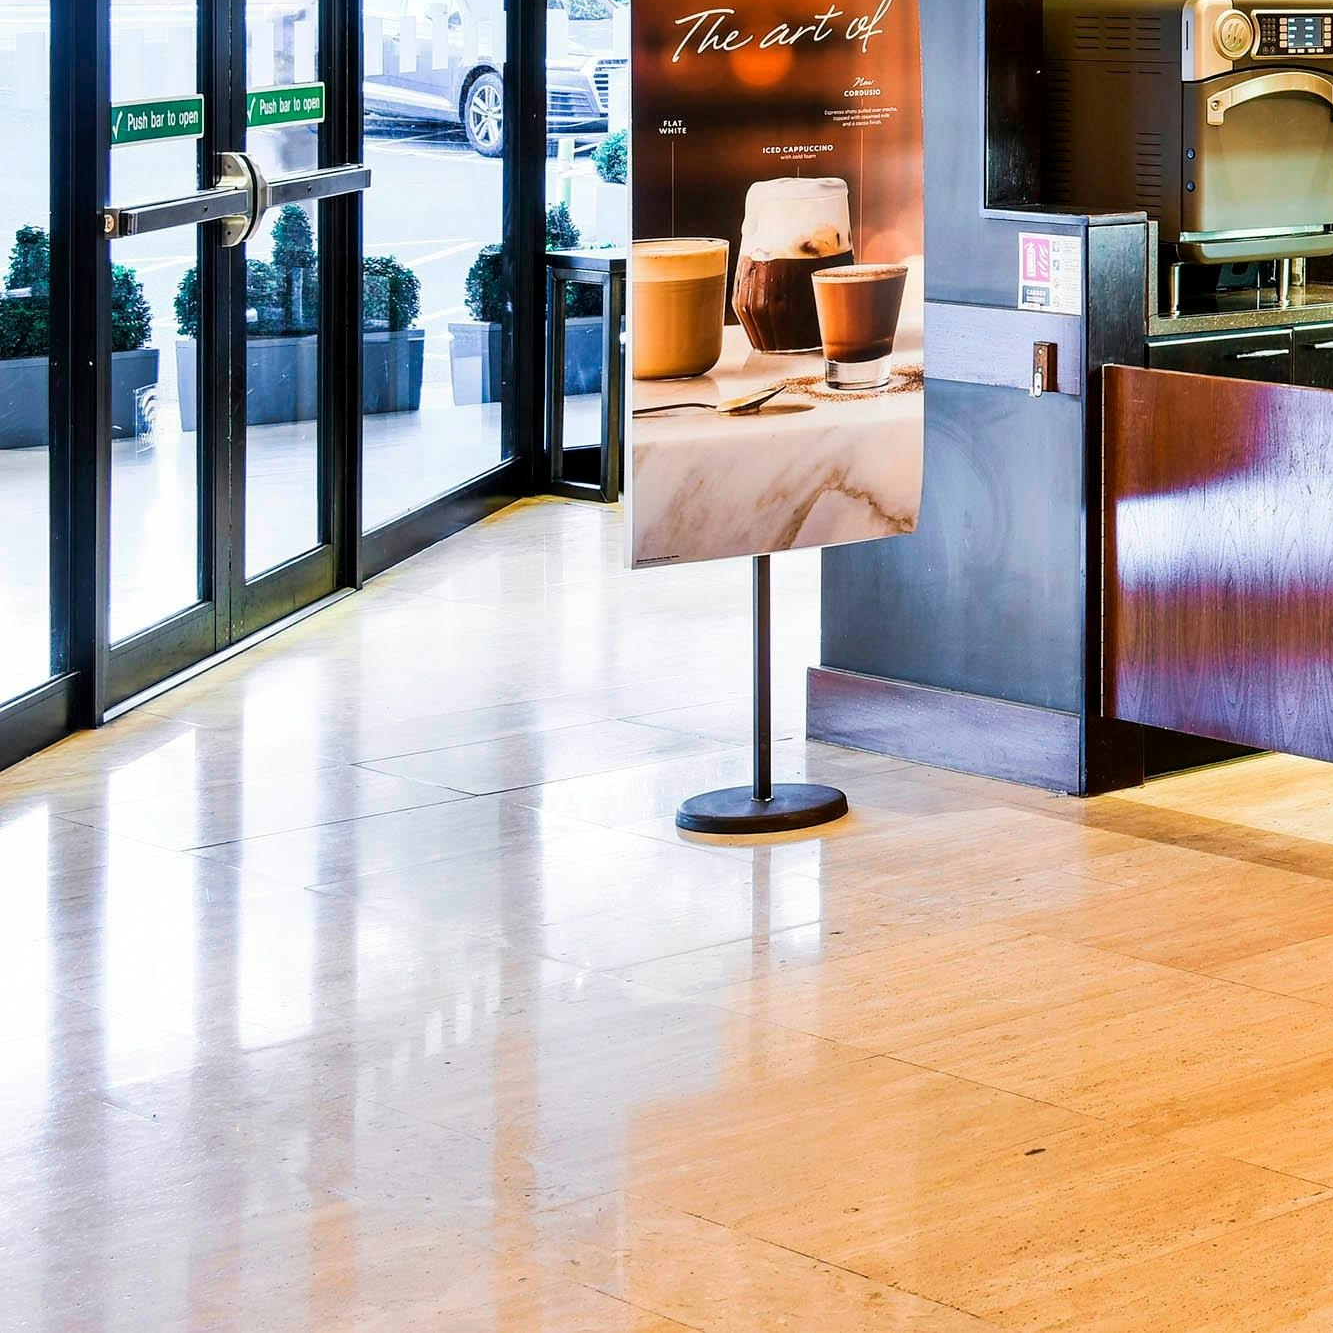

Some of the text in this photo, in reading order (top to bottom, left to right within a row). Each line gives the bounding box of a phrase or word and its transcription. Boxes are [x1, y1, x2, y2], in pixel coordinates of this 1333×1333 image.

[672, 8, 754, 63] The
[759, 4, 843, 49] art
[852, 77, 875, 87] New
[259, 96, 320, 116] Push bar to open
[127, 109, 199, 132] Push bar to open
[658, 127, 687, 135] WHITE
[782, 144, 834, 153] CAPPUCCINO
